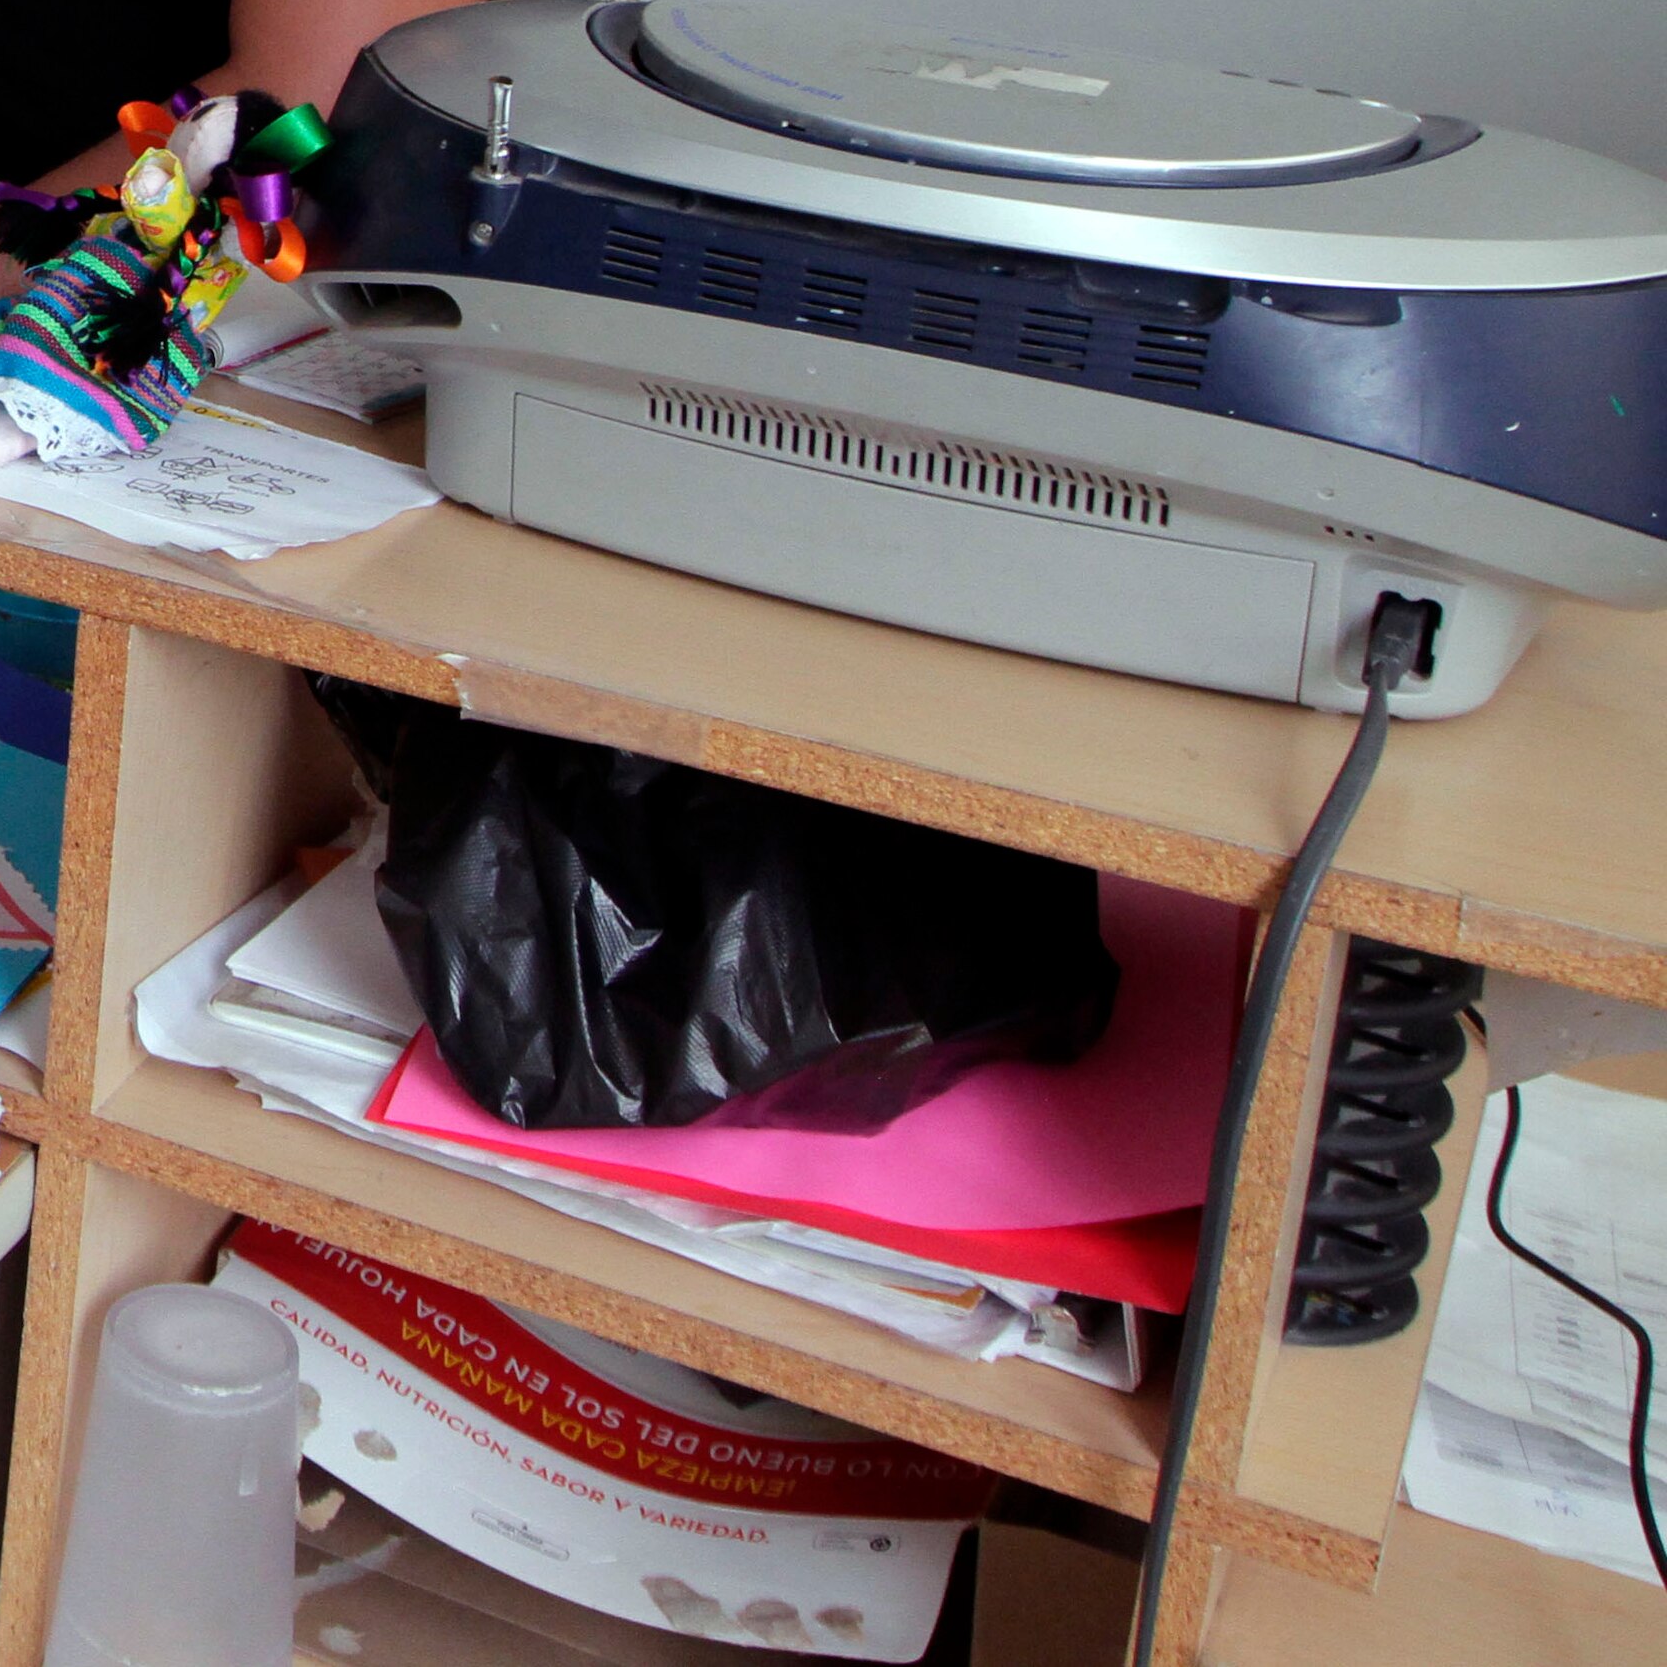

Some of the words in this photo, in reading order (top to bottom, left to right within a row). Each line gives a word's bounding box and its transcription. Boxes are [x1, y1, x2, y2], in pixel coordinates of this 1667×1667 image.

[203, 444, 331, 484] TRANSPORTES
[416, 1295, 498, 1362] CADA
[401, 1318, 535, 1416] MAÑANA
[503, 1355, 551, 1395] EN
[269, 1297, 371, 1375] CALIDAD,
[518, 1456, 606, 1506] SABOR
[613, 1496, 633, 1514] Y
[637, 1504, 771, 1545] VARIEDAD.
[561, 1384, 626, 1429] SOL
[541, 1405, 627, 1460] CADA
[636, 1416, 700, 1456] DEL
[709, 1440, 836, 1478] BUENO
